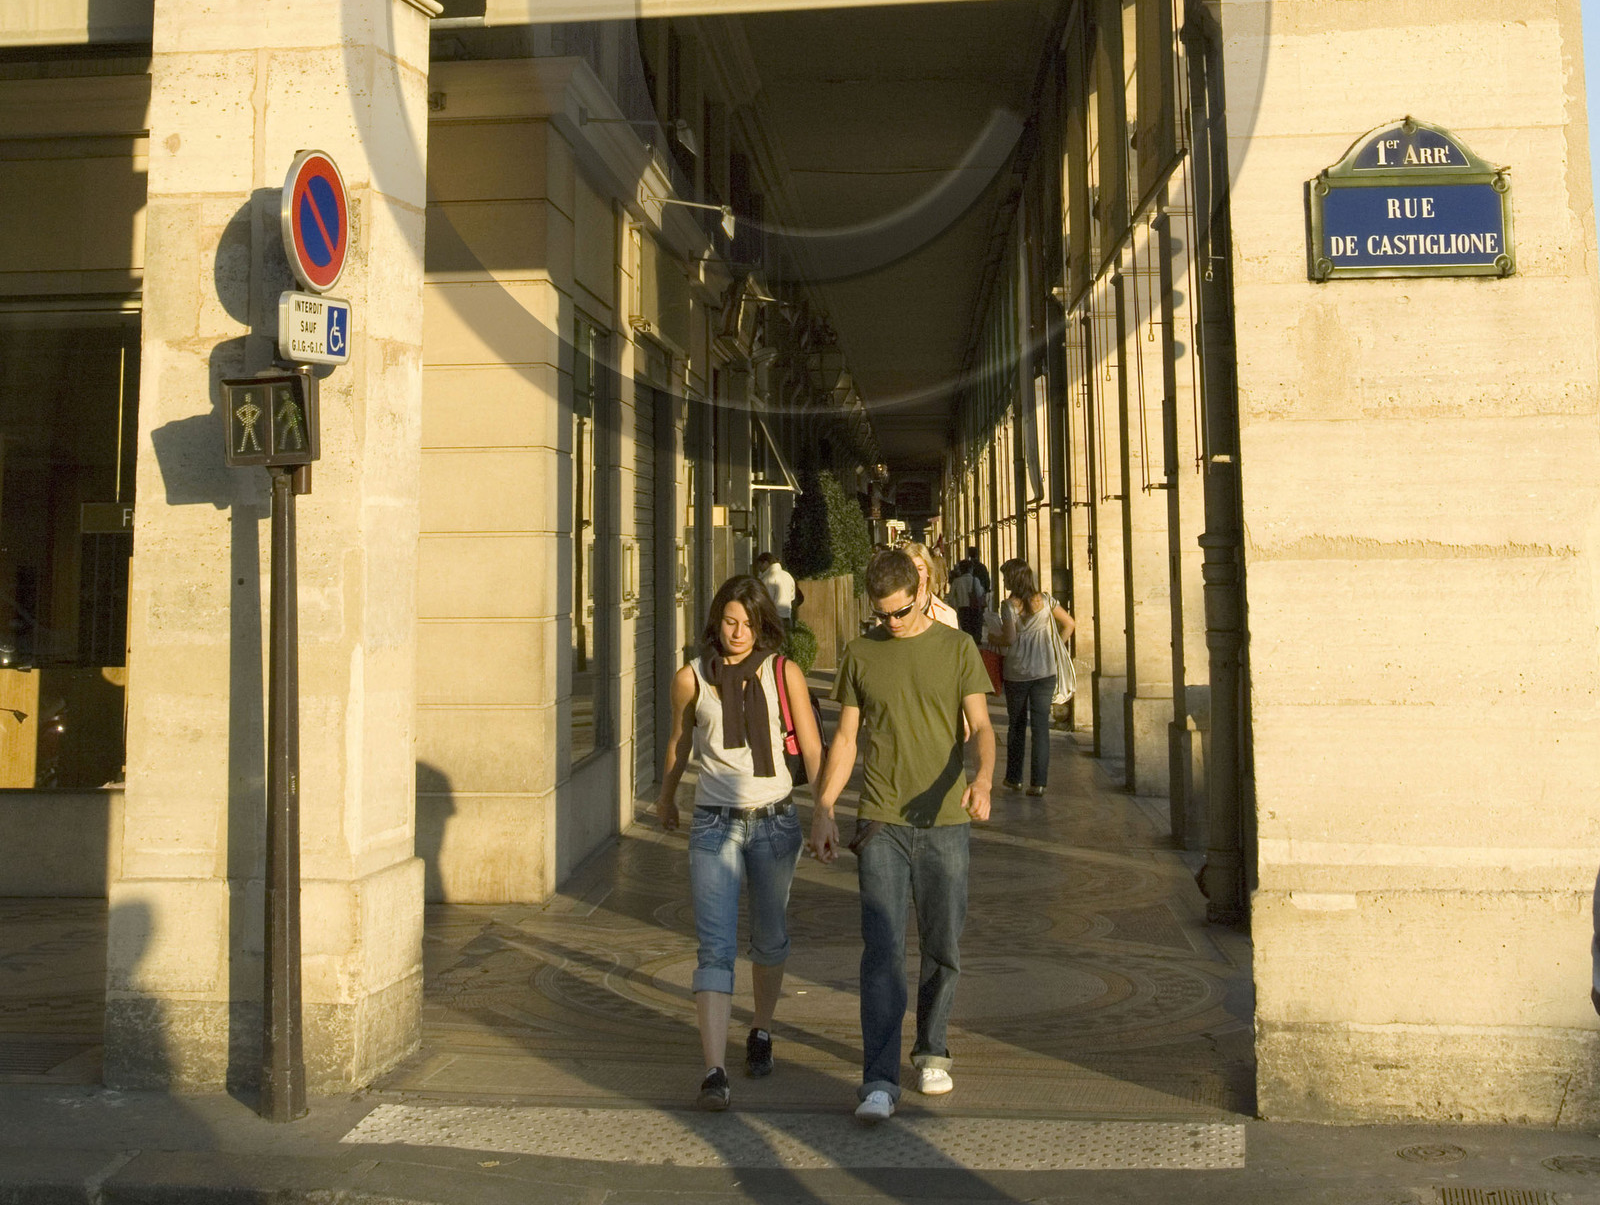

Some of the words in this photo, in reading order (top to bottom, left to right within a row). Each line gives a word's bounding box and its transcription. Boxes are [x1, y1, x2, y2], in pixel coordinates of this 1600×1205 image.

[1387, 198, 1435, 219] RUE
[1330, 236, 1358, 257] DE
[1367, 233, 1498, 256] CASTIGLIONE
[294, 299, 323, 315] INTERDIT
[300, 320, 317, 333] SAUF
